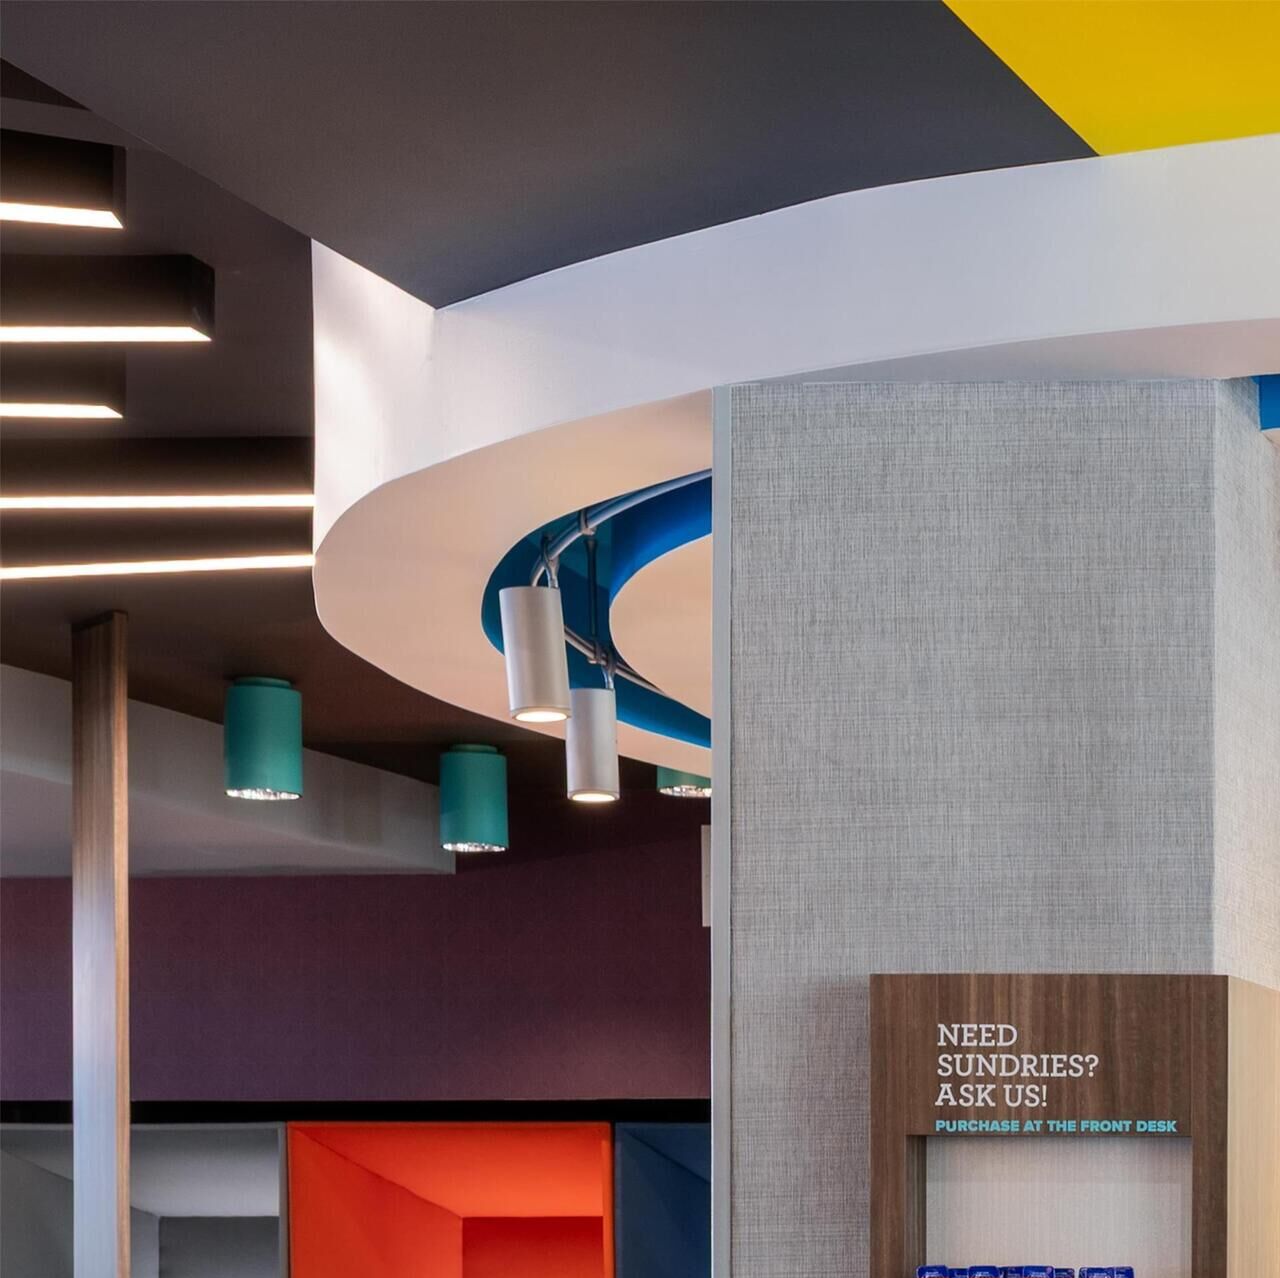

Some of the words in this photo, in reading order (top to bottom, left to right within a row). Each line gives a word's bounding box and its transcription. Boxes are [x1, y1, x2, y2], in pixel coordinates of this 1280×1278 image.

[937, 1023, 1018, 1048] NEED
[936, 1054, 1100, 1078] SUNDRIES?
[935, 1083, 997, 1108] ASK
[1004, 1083, 1048, 1108] US!
[935, 1120, 1020, 1133] PURCHASE
[1023, 1120, 1043, 1132] AT
[1047, 1120, 1077, 1132] THE
[1081, 1120, 1132, 1132] FRONT
[1136, 1120, 1177, 1133] DESK
